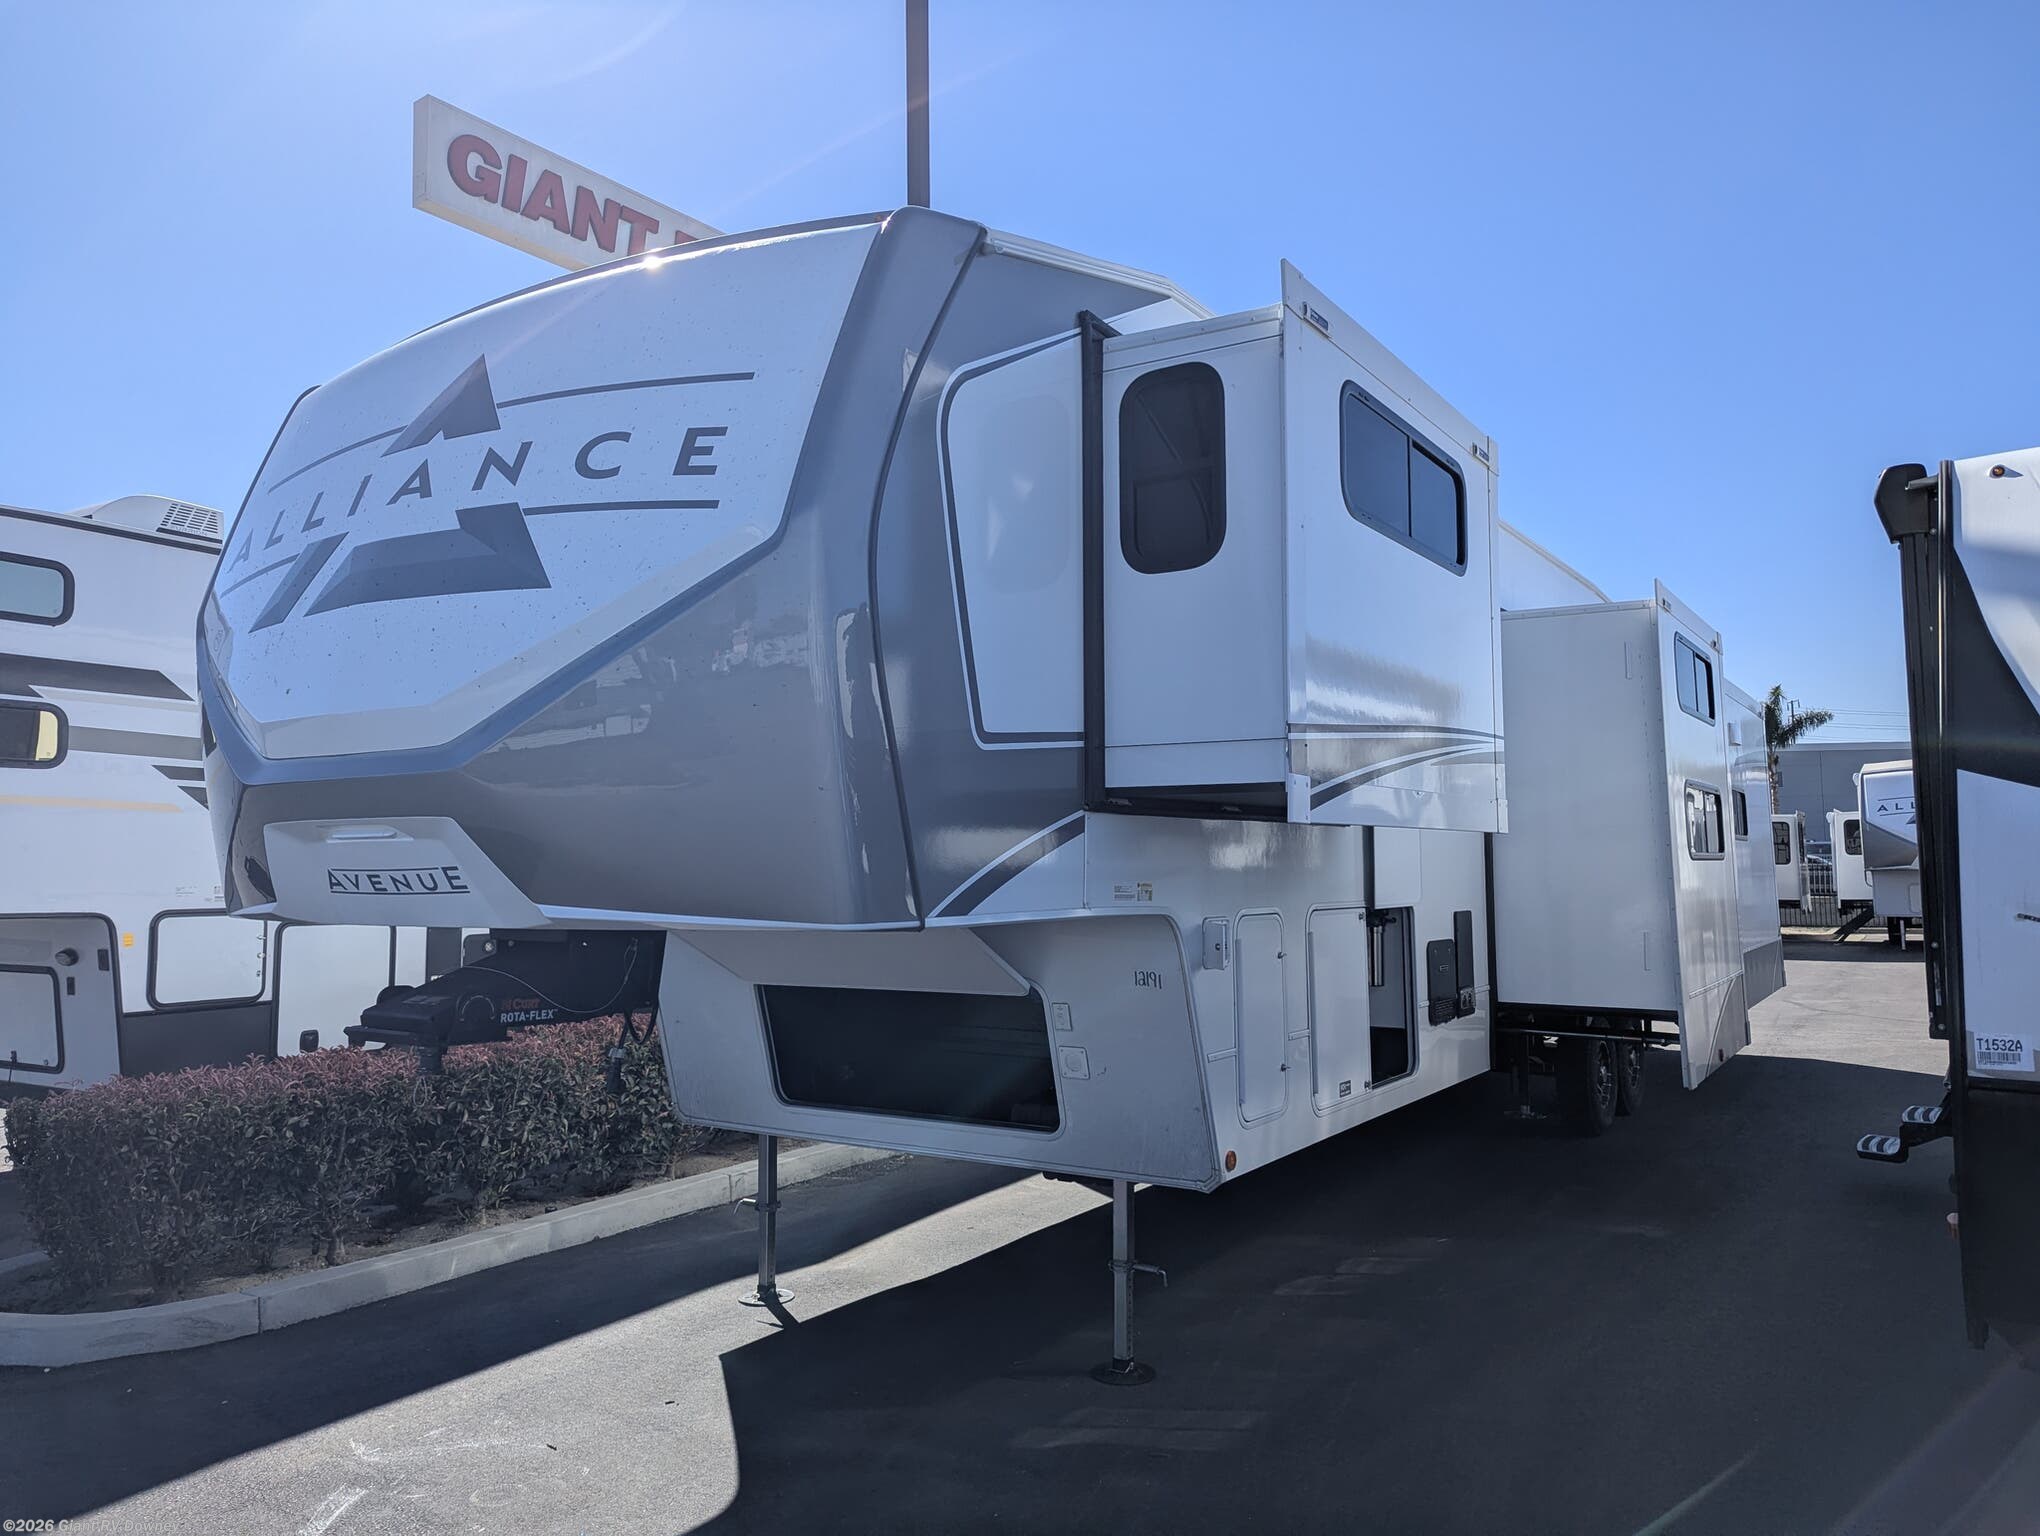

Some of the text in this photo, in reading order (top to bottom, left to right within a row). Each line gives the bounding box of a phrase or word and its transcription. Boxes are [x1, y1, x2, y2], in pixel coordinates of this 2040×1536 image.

[447, 134, 660, 257] GIANT
[230, 426, 729, 572] ALLIANCE
[328, 866, 470, 894] AVENUE
[1976, 1038, 2023, 1052] T1532A
